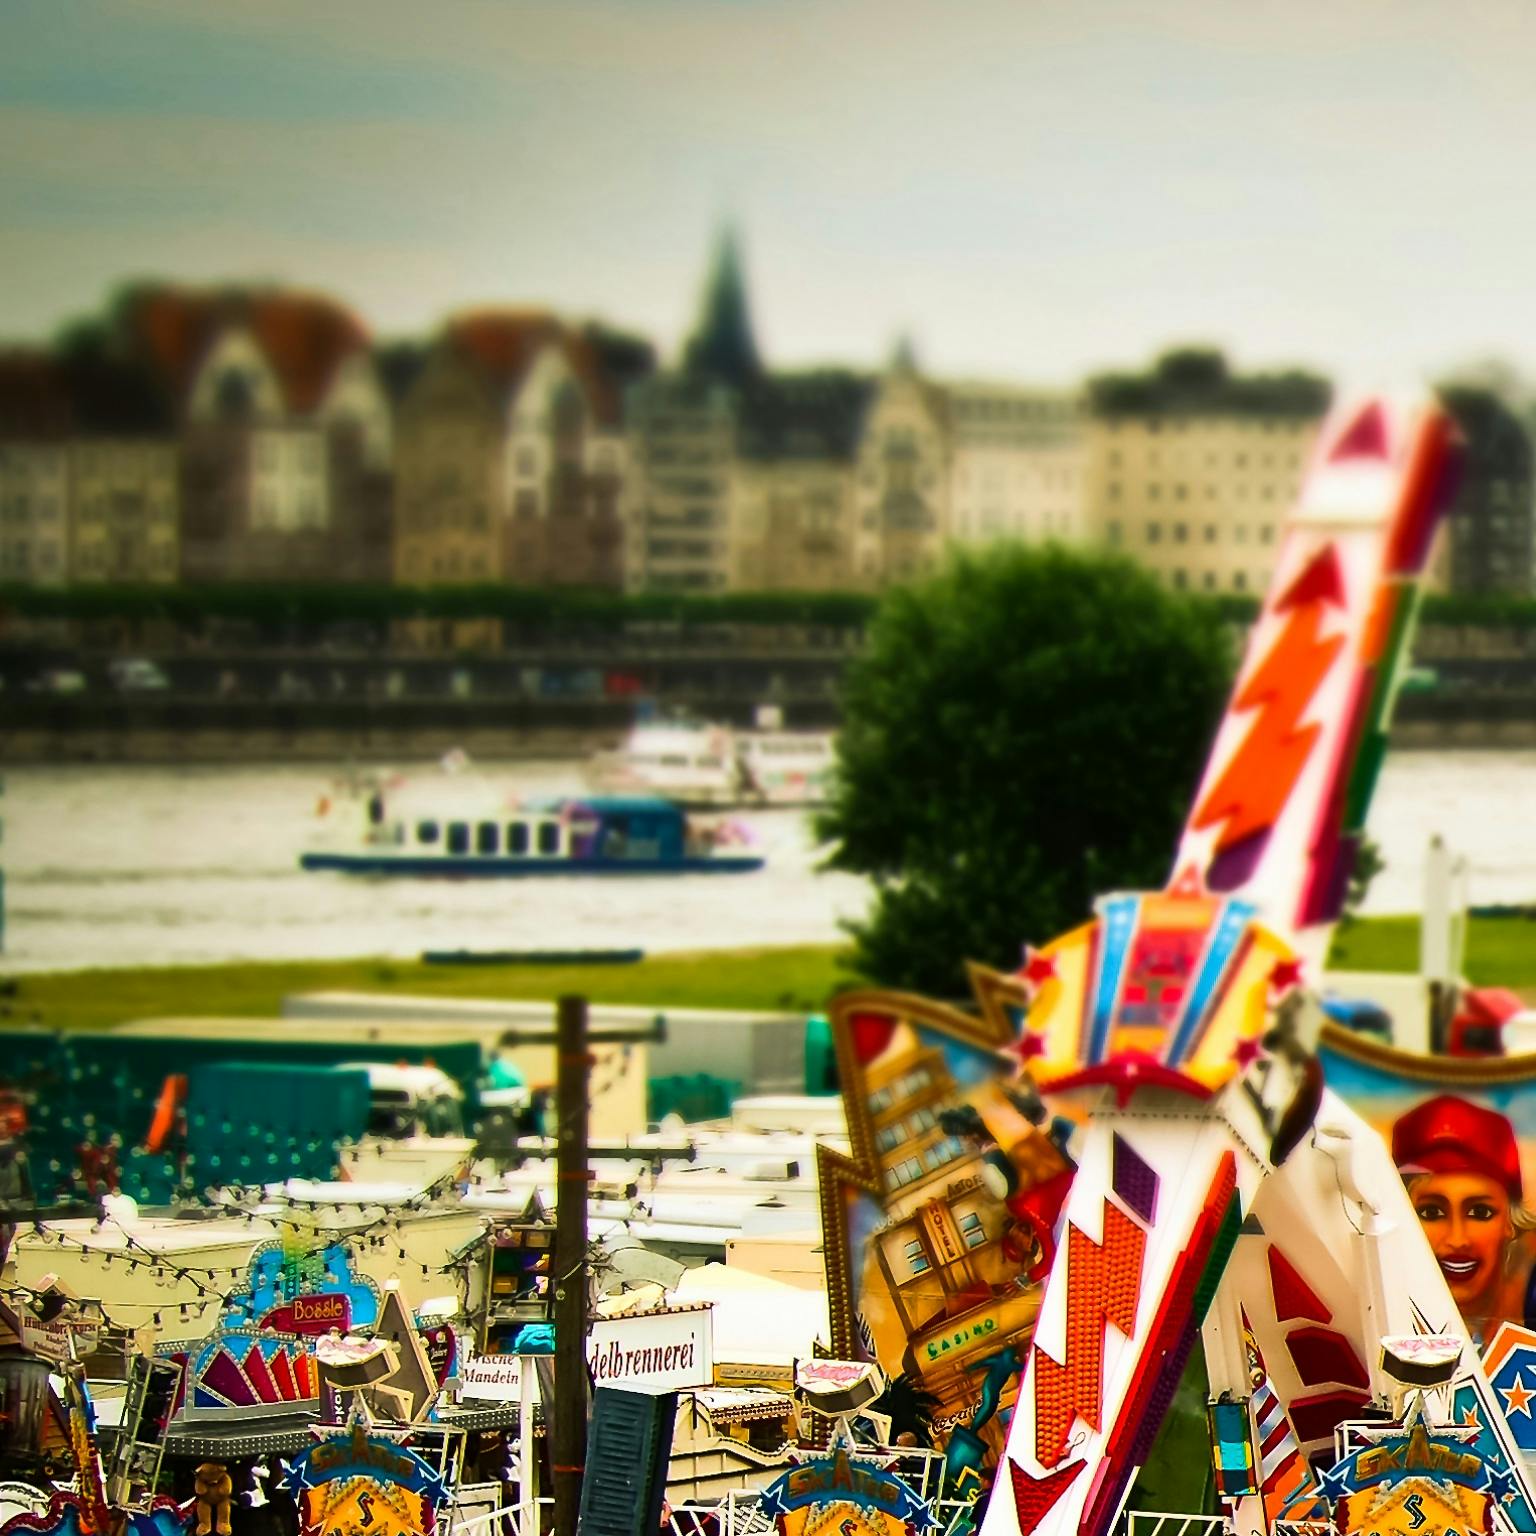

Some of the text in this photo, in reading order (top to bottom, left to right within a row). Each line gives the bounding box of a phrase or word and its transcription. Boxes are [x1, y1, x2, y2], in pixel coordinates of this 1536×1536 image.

[294, 1299, 344, 1321] Bossle
[590, 1331, 696, 1382] delbrennerei
[927, 1318, 995, 1358] CASINO
